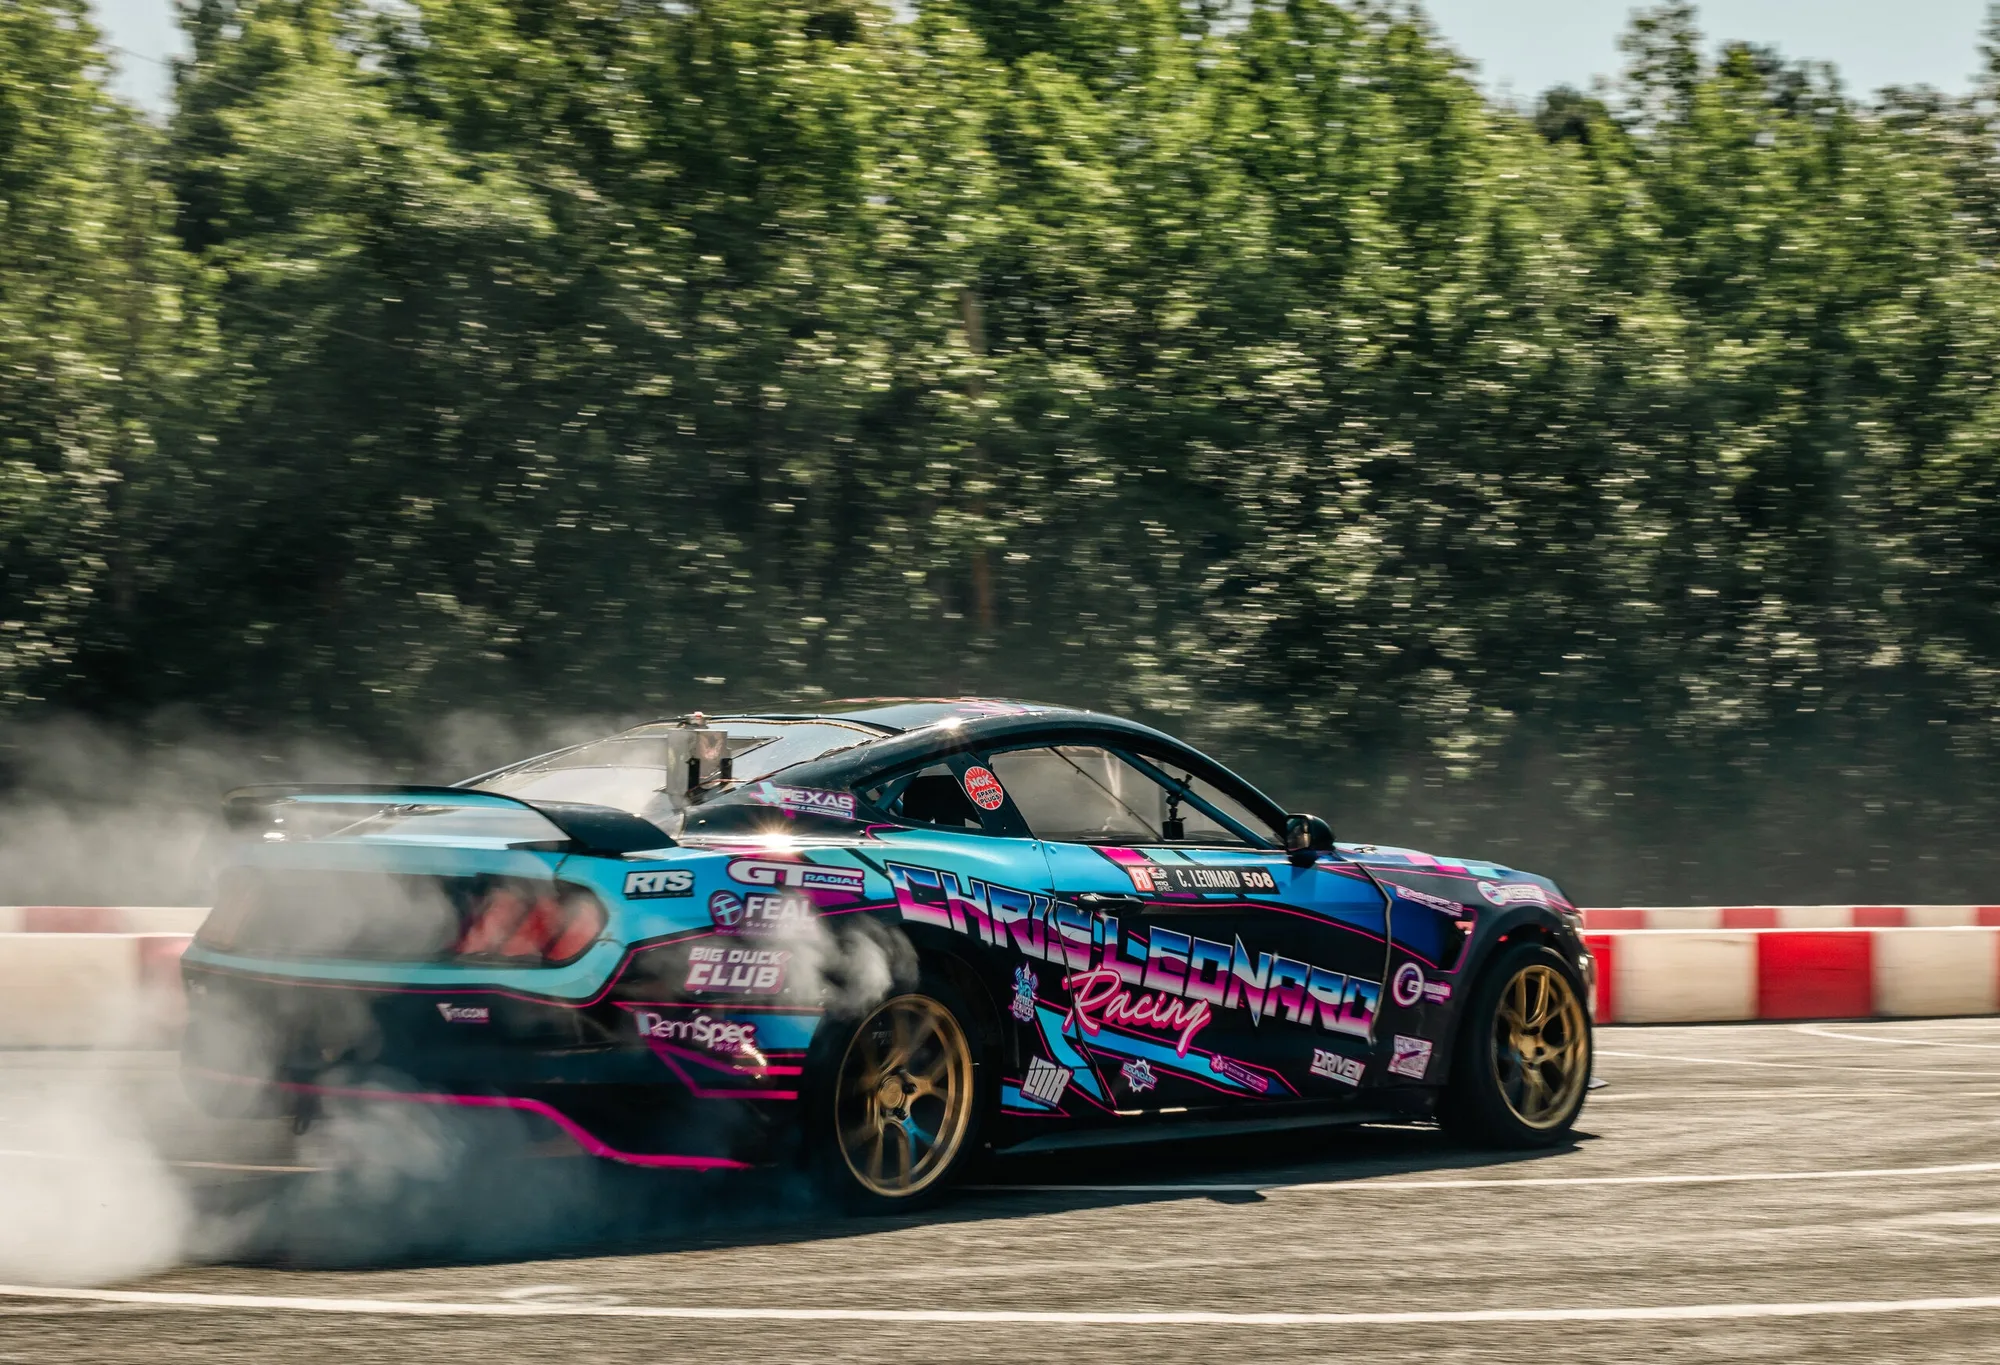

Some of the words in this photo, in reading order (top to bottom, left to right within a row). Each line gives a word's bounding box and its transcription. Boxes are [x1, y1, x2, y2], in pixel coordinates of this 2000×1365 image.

[968, 774, 993, 790] NGK
[776, 787, 853, 810] TEXAS
[623, 870, 693, 894] RTS
[727, 859, 805, 888] GT
[803, 873, 862, 886] RADIAL
[1175, 869, 1191, 888] C.
[1189, 869, 1241, 888] LEONARD
[1241, 871, 1275, 888] 508
[744, 896, 816, 921] FEAL
[689, 947, 726, 962] BIG
[727, 949, 785, 965] DUCK
[887, 862, 1094, 973] CHRIS
[1102, 914, 1384, 1046] LEONARD
[685, 963, 780, 988] CLUB
[1061, 964, 1210, 1053] Racing
[1311, 1048, 1367, 1081] DRIVEN
